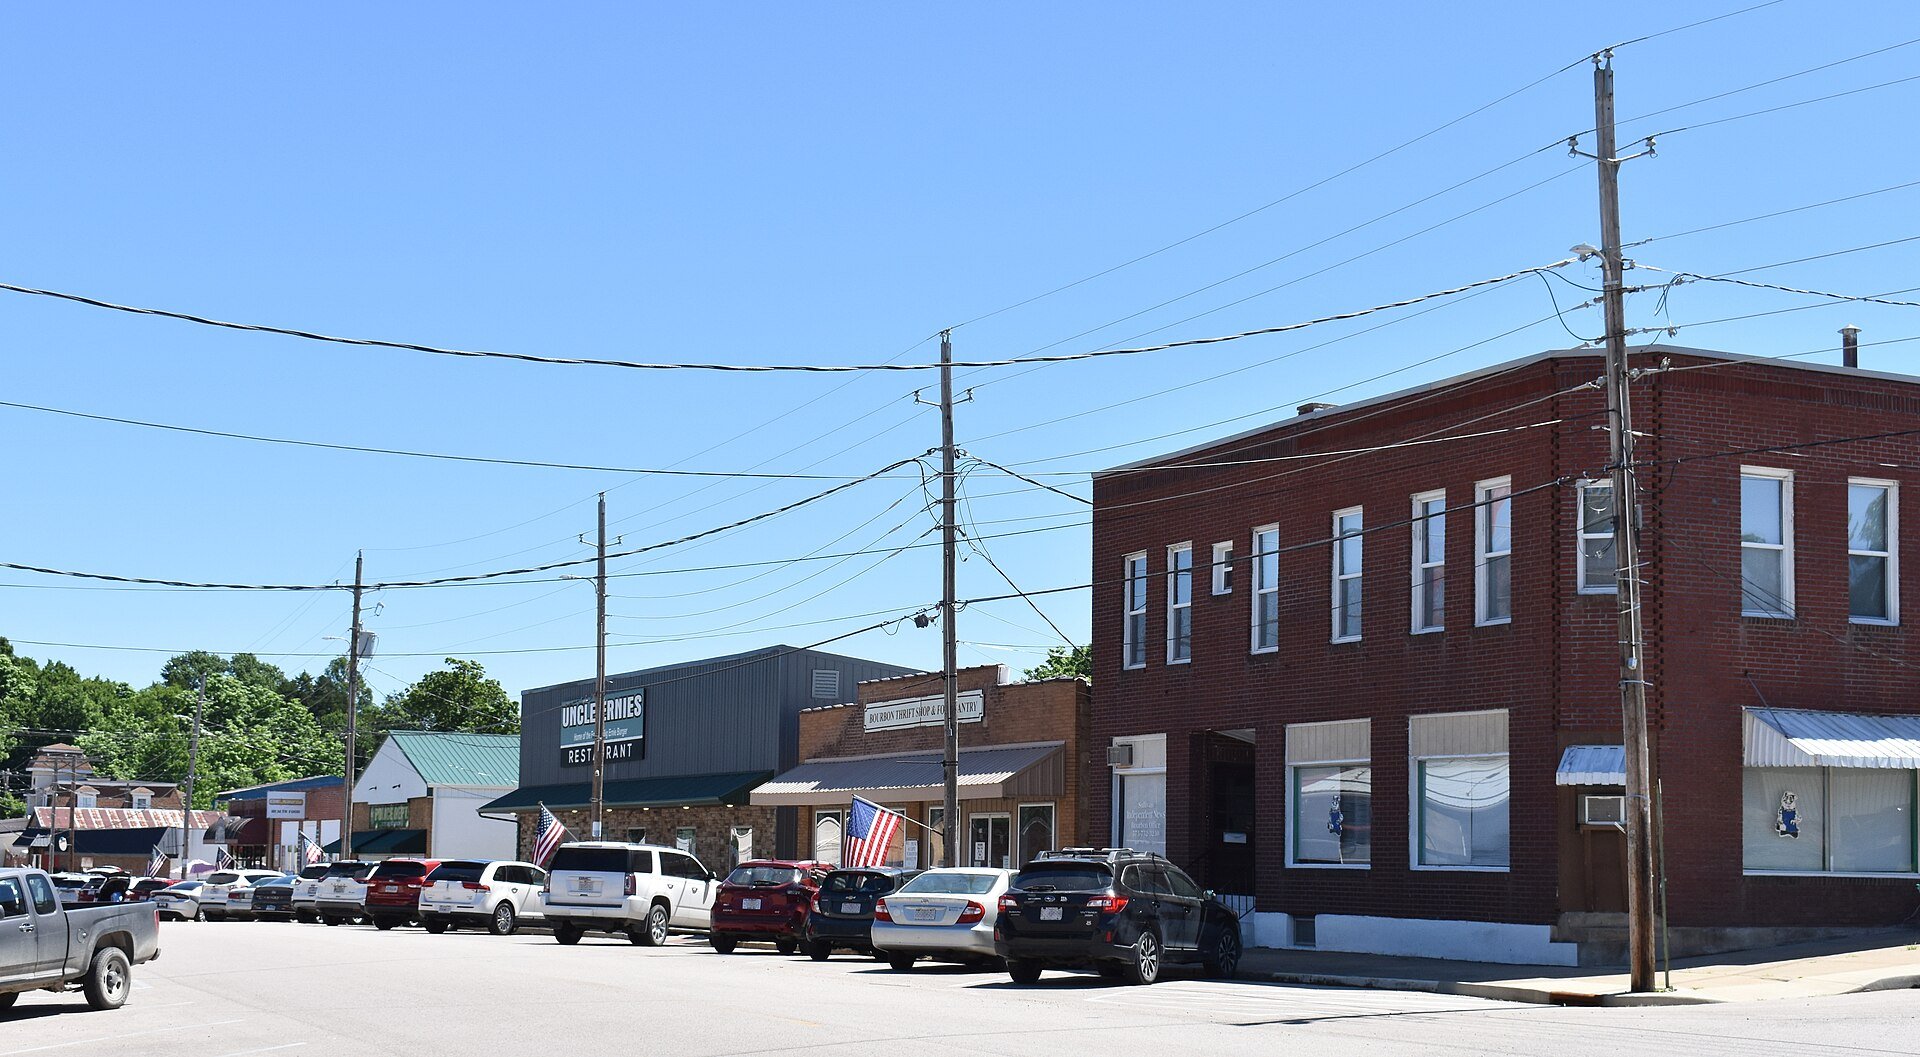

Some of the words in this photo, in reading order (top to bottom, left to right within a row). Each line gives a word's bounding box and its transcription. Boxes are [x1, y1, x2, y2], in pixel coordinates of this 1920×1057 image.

[562, 702, 596, 728] UNCLE
[869, 711, 895, 723] BOURBON
[895, 708, 915, 720] THRIFT
[915, 705, 930, 717] SHOP
[931, 705, 936, 716] &
[958, 701, 978, 713] ANTRY
[568, 743, 632, 763] RESTRANT
